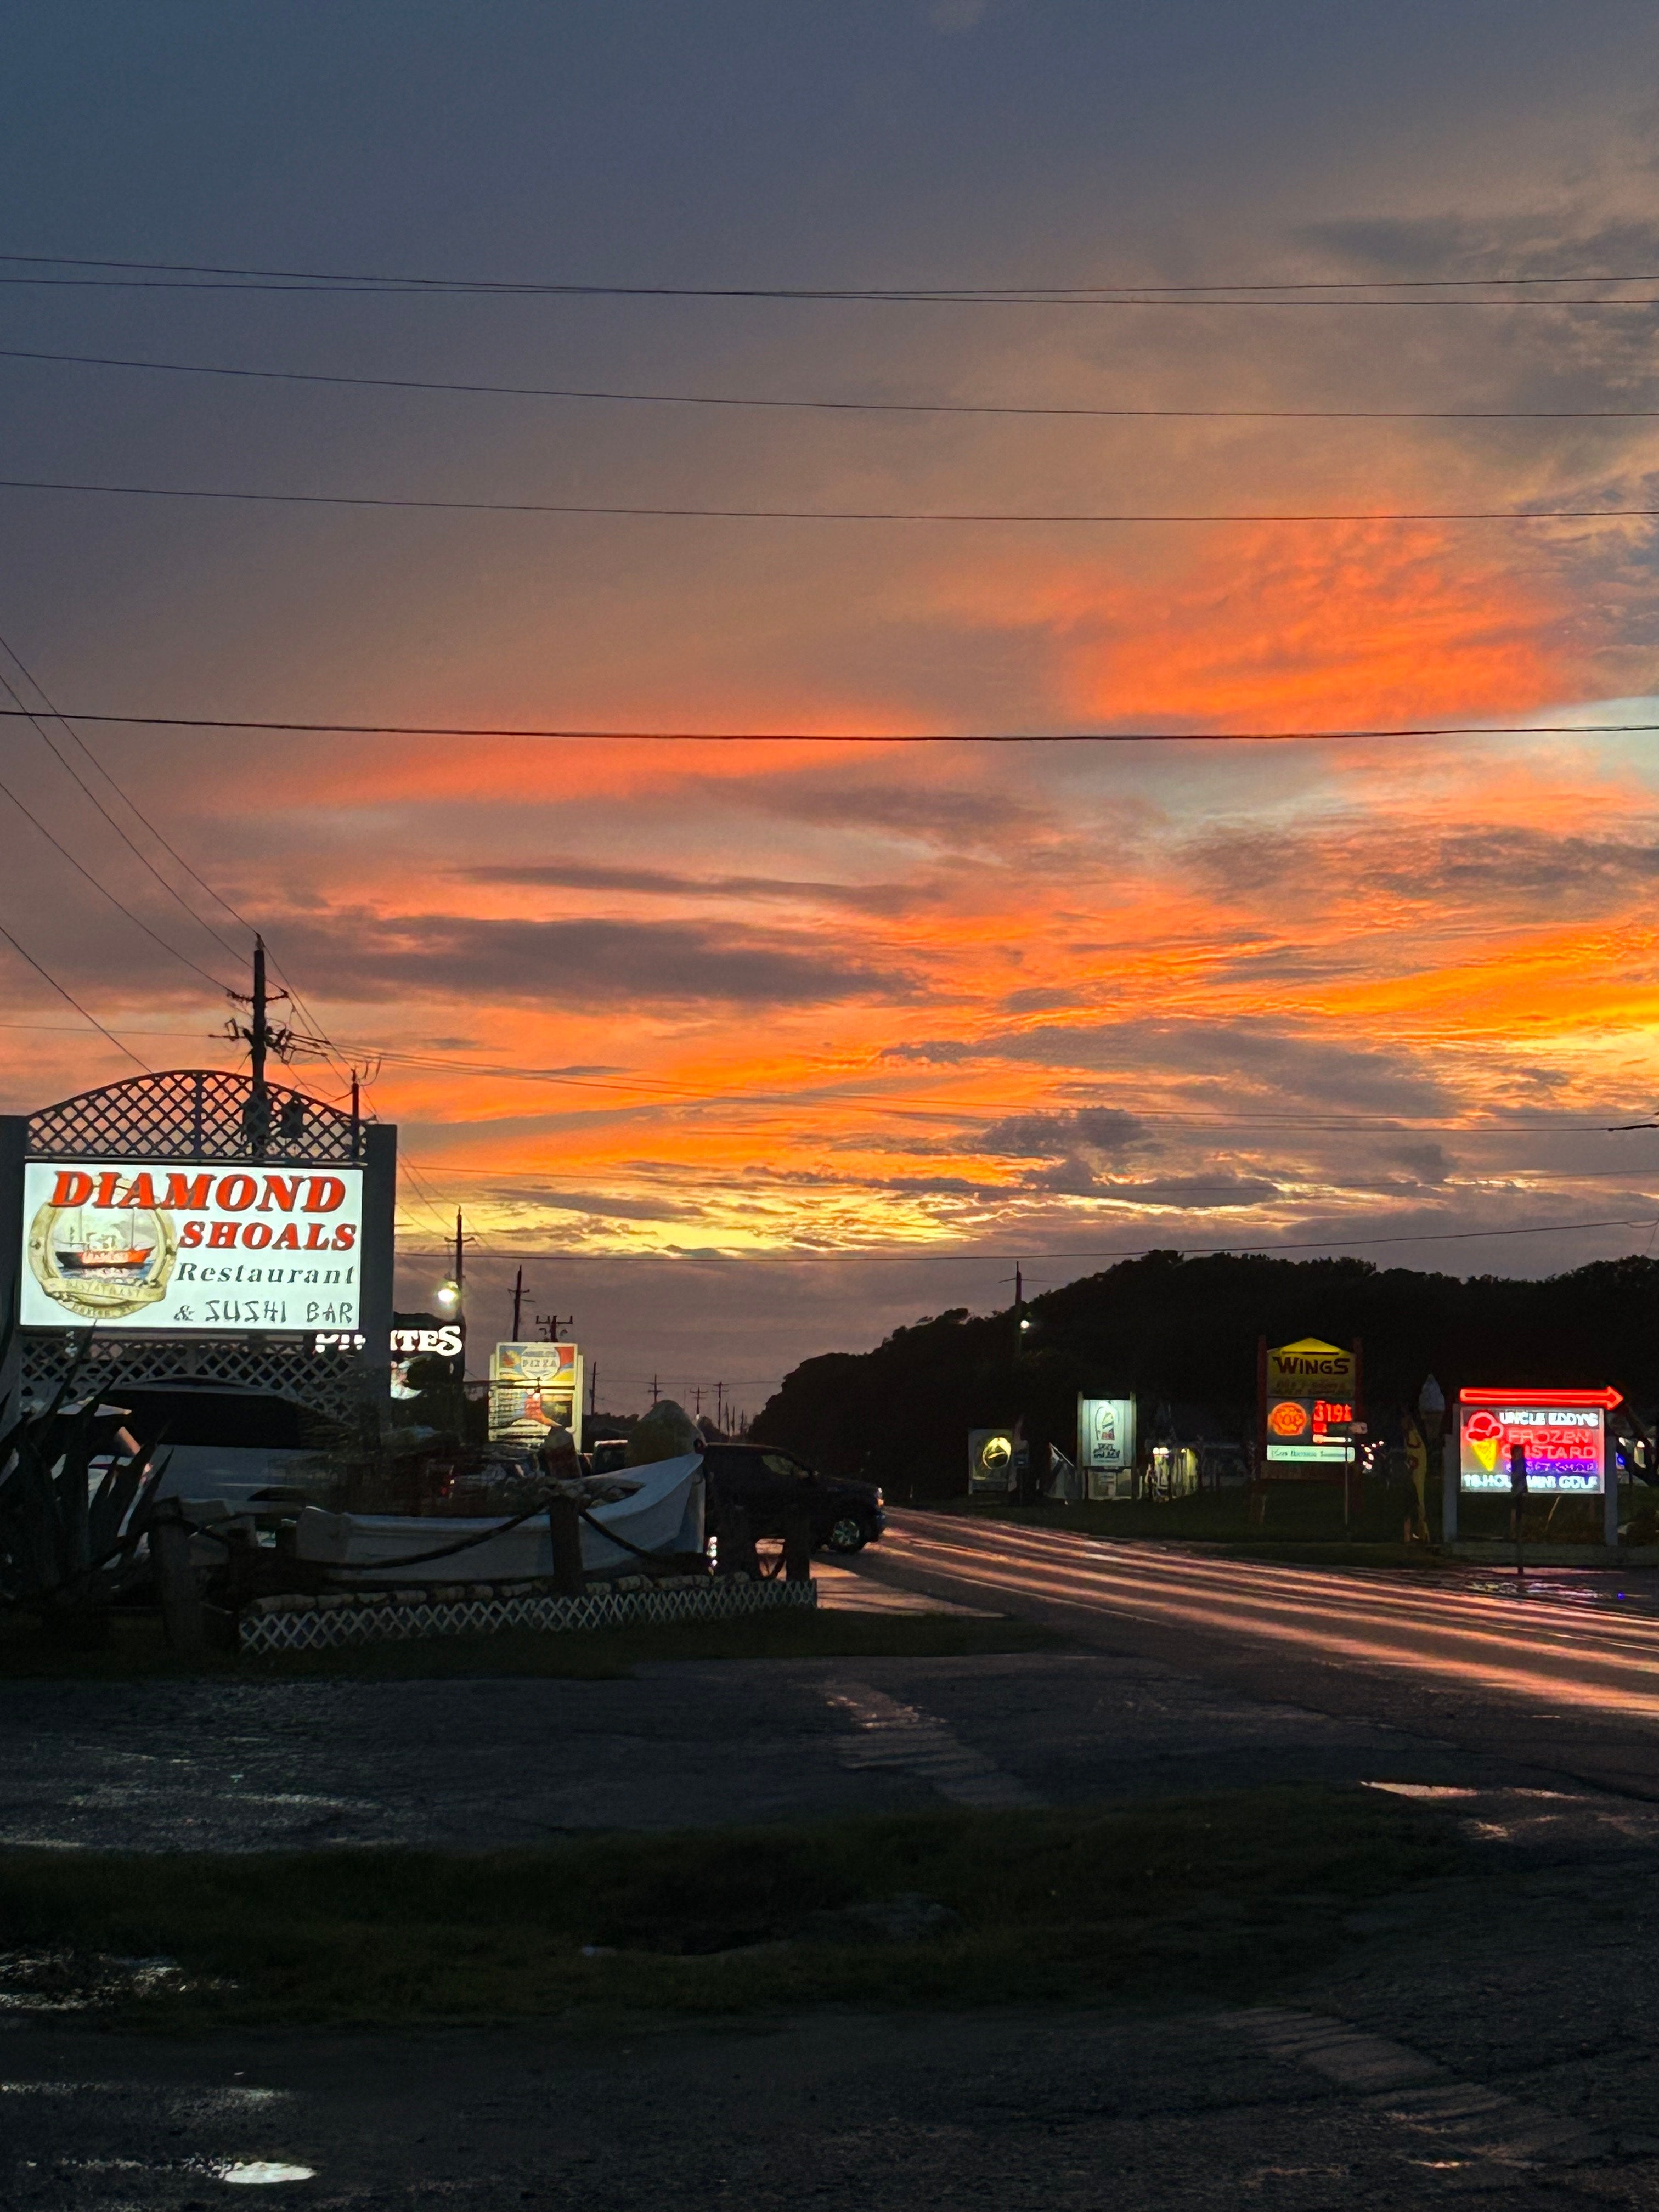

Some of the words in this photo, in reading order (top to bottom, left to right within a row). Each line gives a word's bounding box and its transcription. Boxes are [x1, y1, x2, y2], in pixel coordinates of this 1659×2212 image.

[49, 1170, 346, 1213] DIAMOND
[179, 1221, 357, 1251] SHOALS
[175, 1262, 355, 1284] Restaurant
[173, 1305, 194, 1323] &
[205, 1300, 287, 1323] SUSHI
[306, 1301, 353, 1323] BAR
[1272, 1357, 1350, 1375] WINGS
[1508, 1430, 1591, 1444] FROZEN
[1559, 1475, 1598, 1489] GOLF
